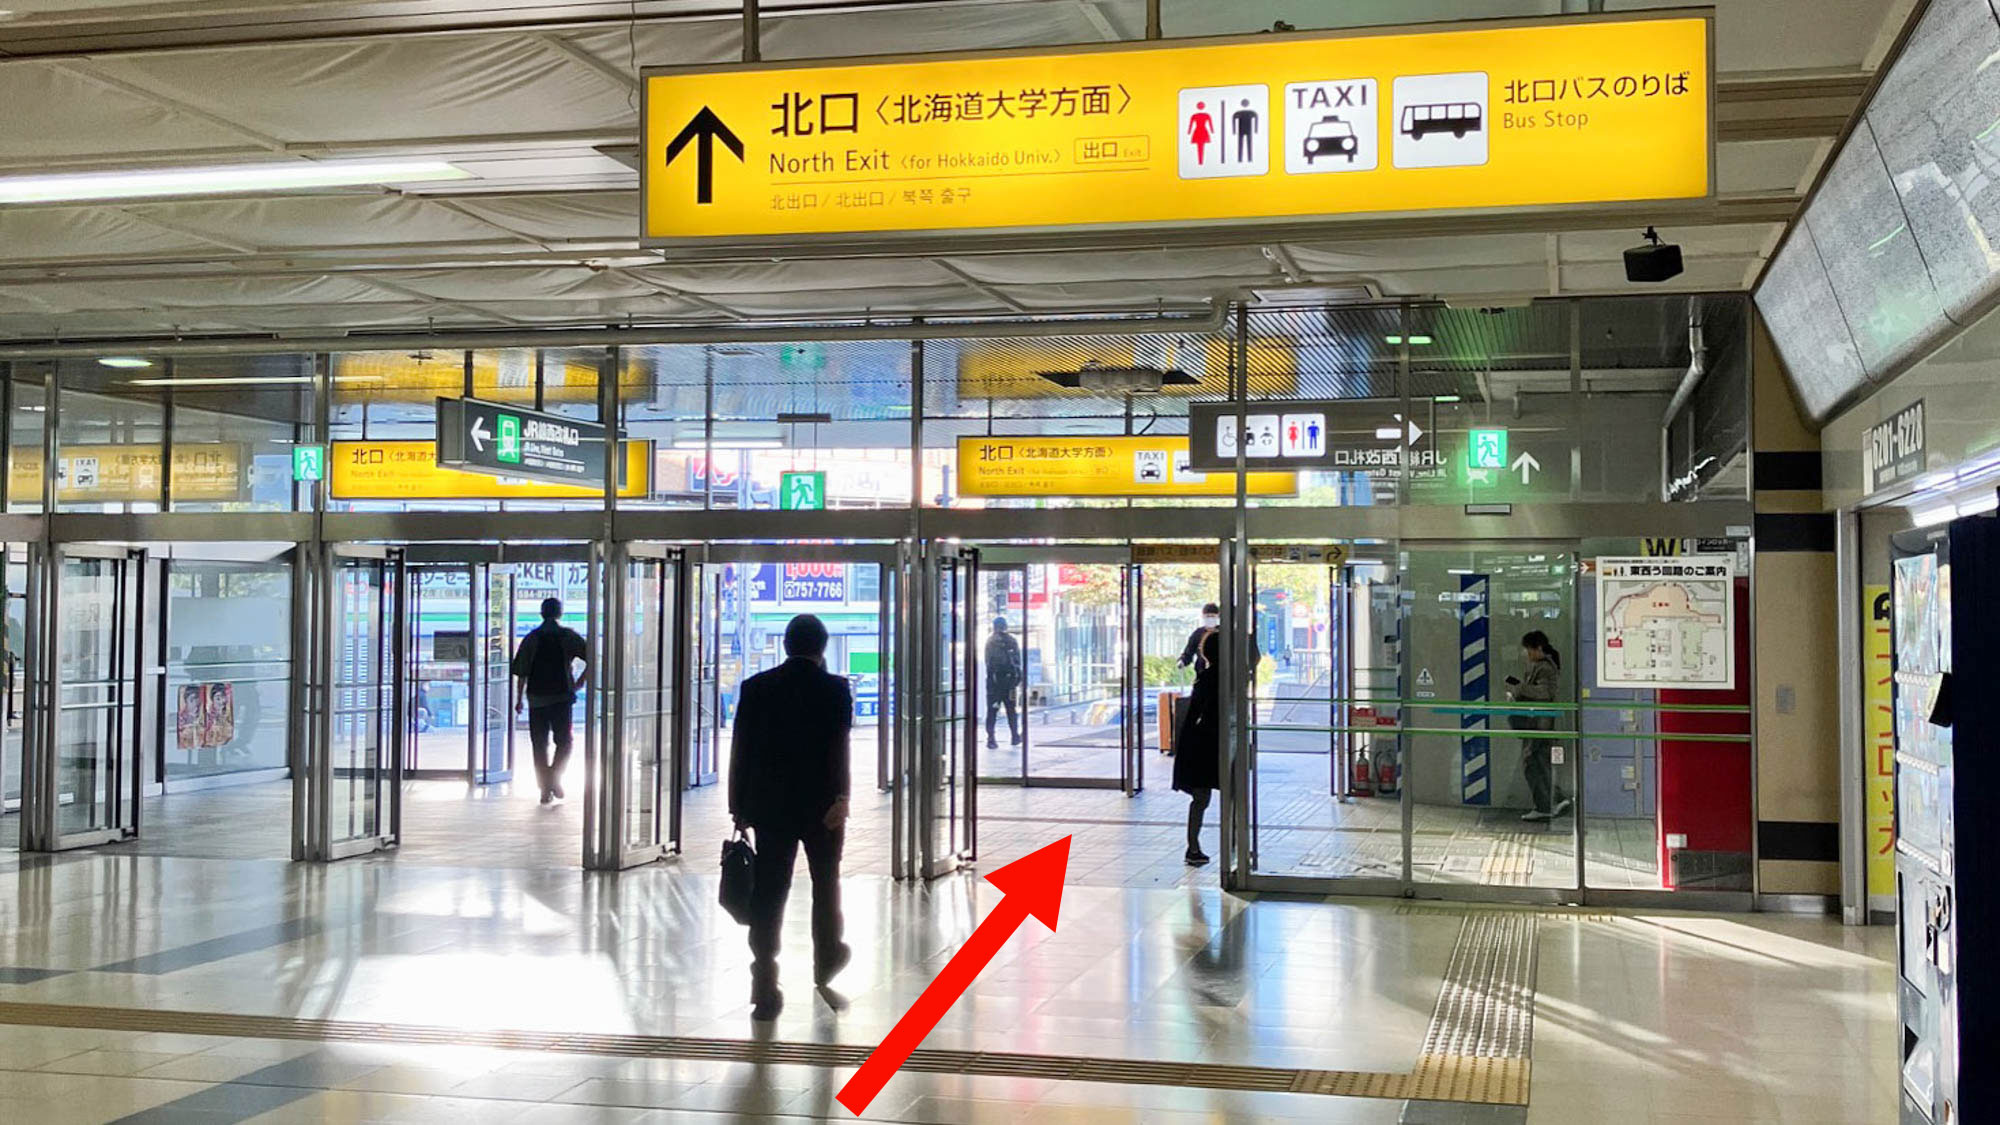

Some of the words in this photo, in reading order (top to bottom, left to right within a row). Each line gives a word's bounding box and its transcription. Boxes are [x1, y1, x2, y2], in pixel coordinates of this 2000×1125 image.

[1292, 84, 1367, 110] TAXI
[1503, 70, 1691, 105] 北口バスのりば
[771, 92, 859, 137] 北口
[1503, 110, 1536, 130] Bus
[1543, 109, 1589, 129] Stop
[1083, 141, 1118, 160] 出口
[769, 151, 835, 174] North
[846, 149, 889, 171] Exit
[352, 448, 384, 464] 北口
[978, 444, 1013, 461] 北口
[1138, 452, 1165, 461] TAXI
[979, 466, 1005, 475] North
[1007, 466, 1025, 475] Exit
